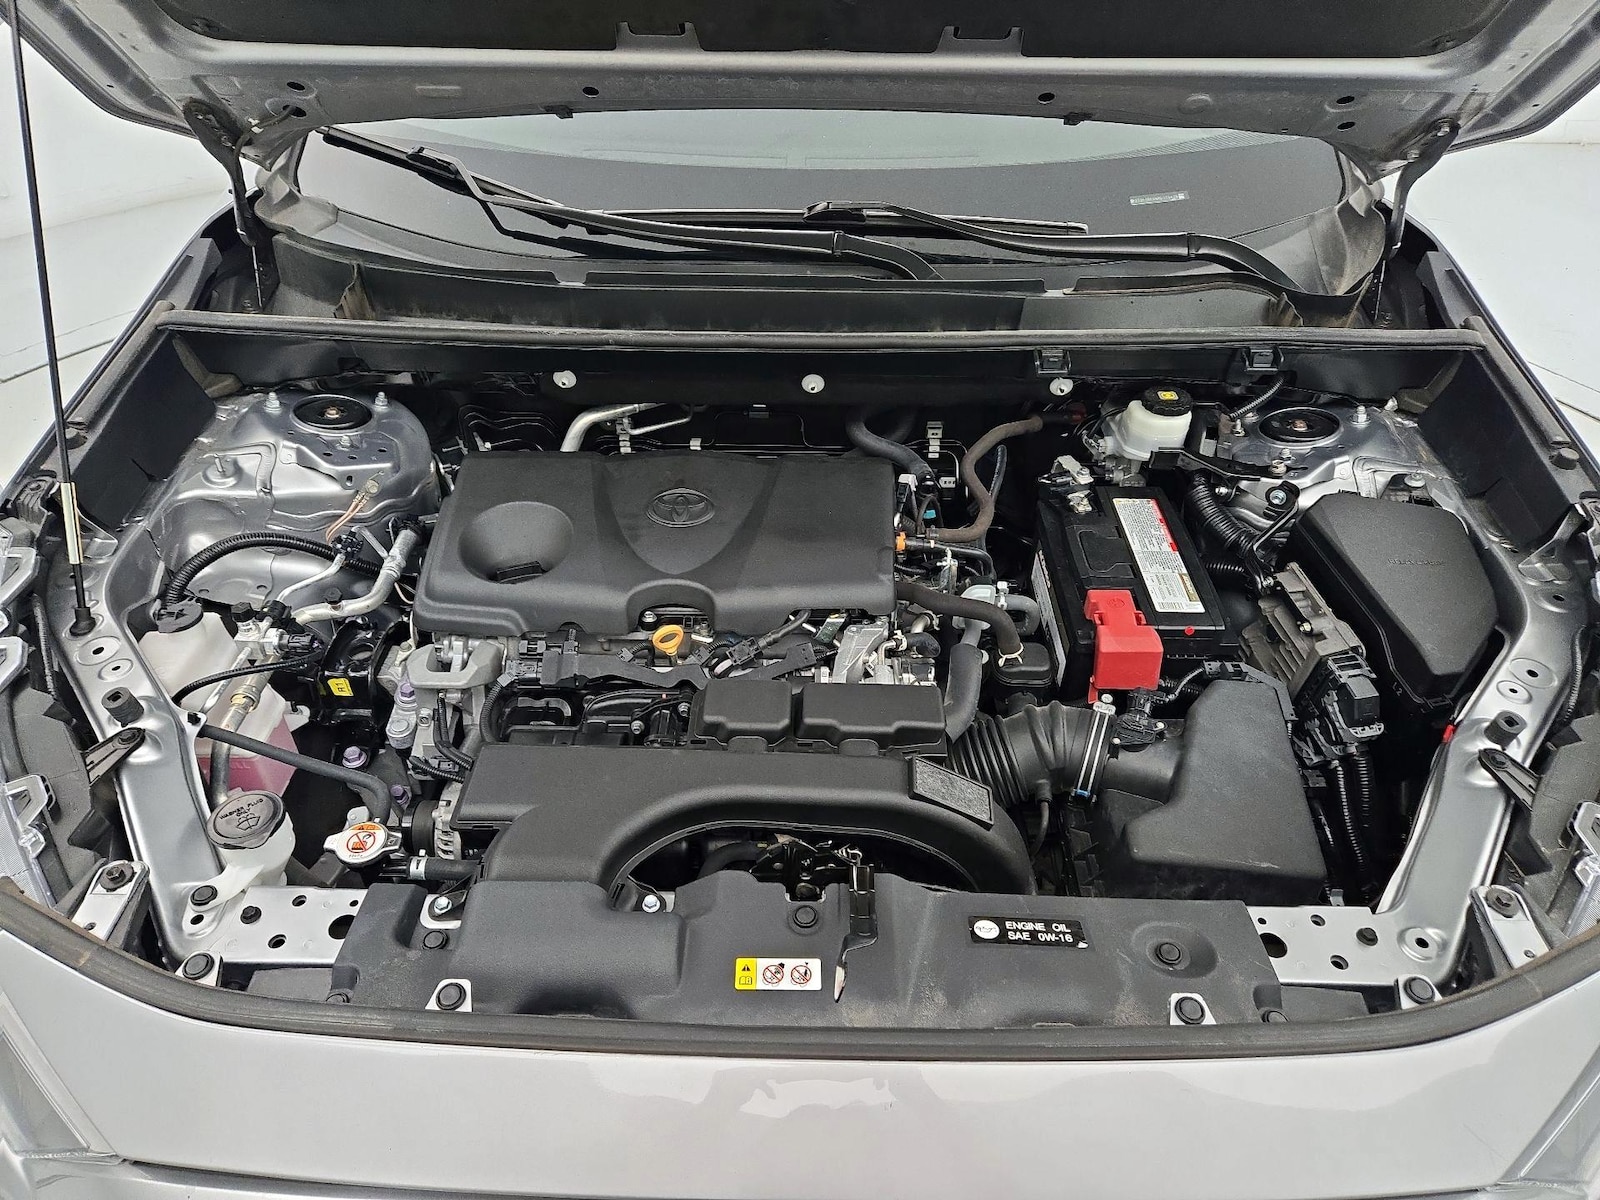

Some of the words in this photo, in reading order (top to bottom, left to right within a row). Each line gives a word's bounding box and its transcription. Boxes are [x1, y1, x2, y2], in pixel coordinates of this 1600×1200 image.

[1005, 921, 1046, 931] ENGINE
[1051, 923, 1072, 933] OIL
[1007, 931, 1032, 941] SAE
[1037, 932, 1074, 943] 0W-16
